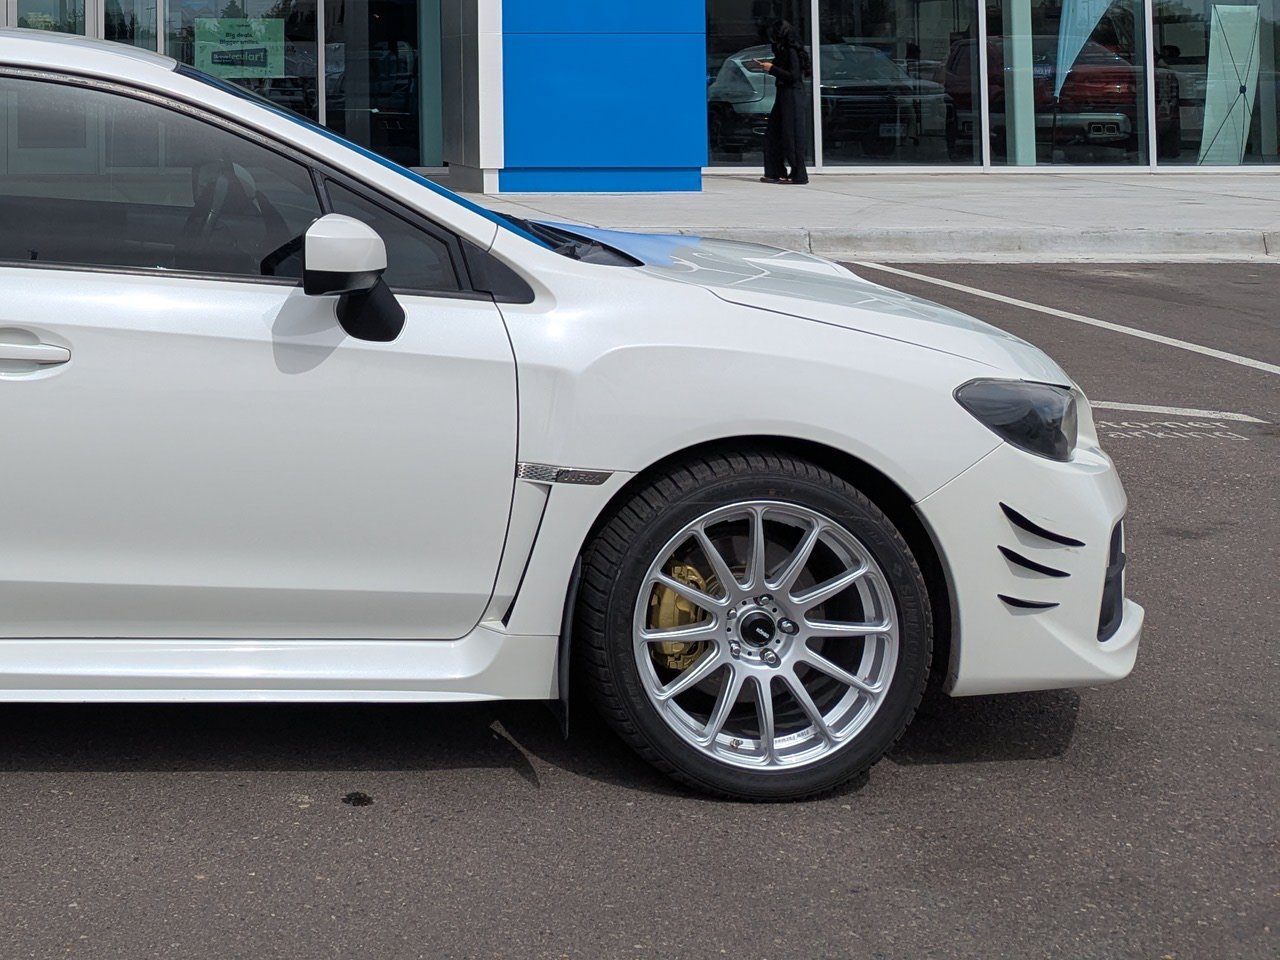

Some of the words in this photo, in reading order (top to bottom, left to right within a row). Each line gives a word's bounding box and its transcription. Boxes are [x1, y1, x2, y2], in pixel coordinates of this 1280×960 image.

[1097, 420, 1230, 429] tomer
[1105, 431, 1250, 441] arking
[562, 472, 600, 483] WRX
